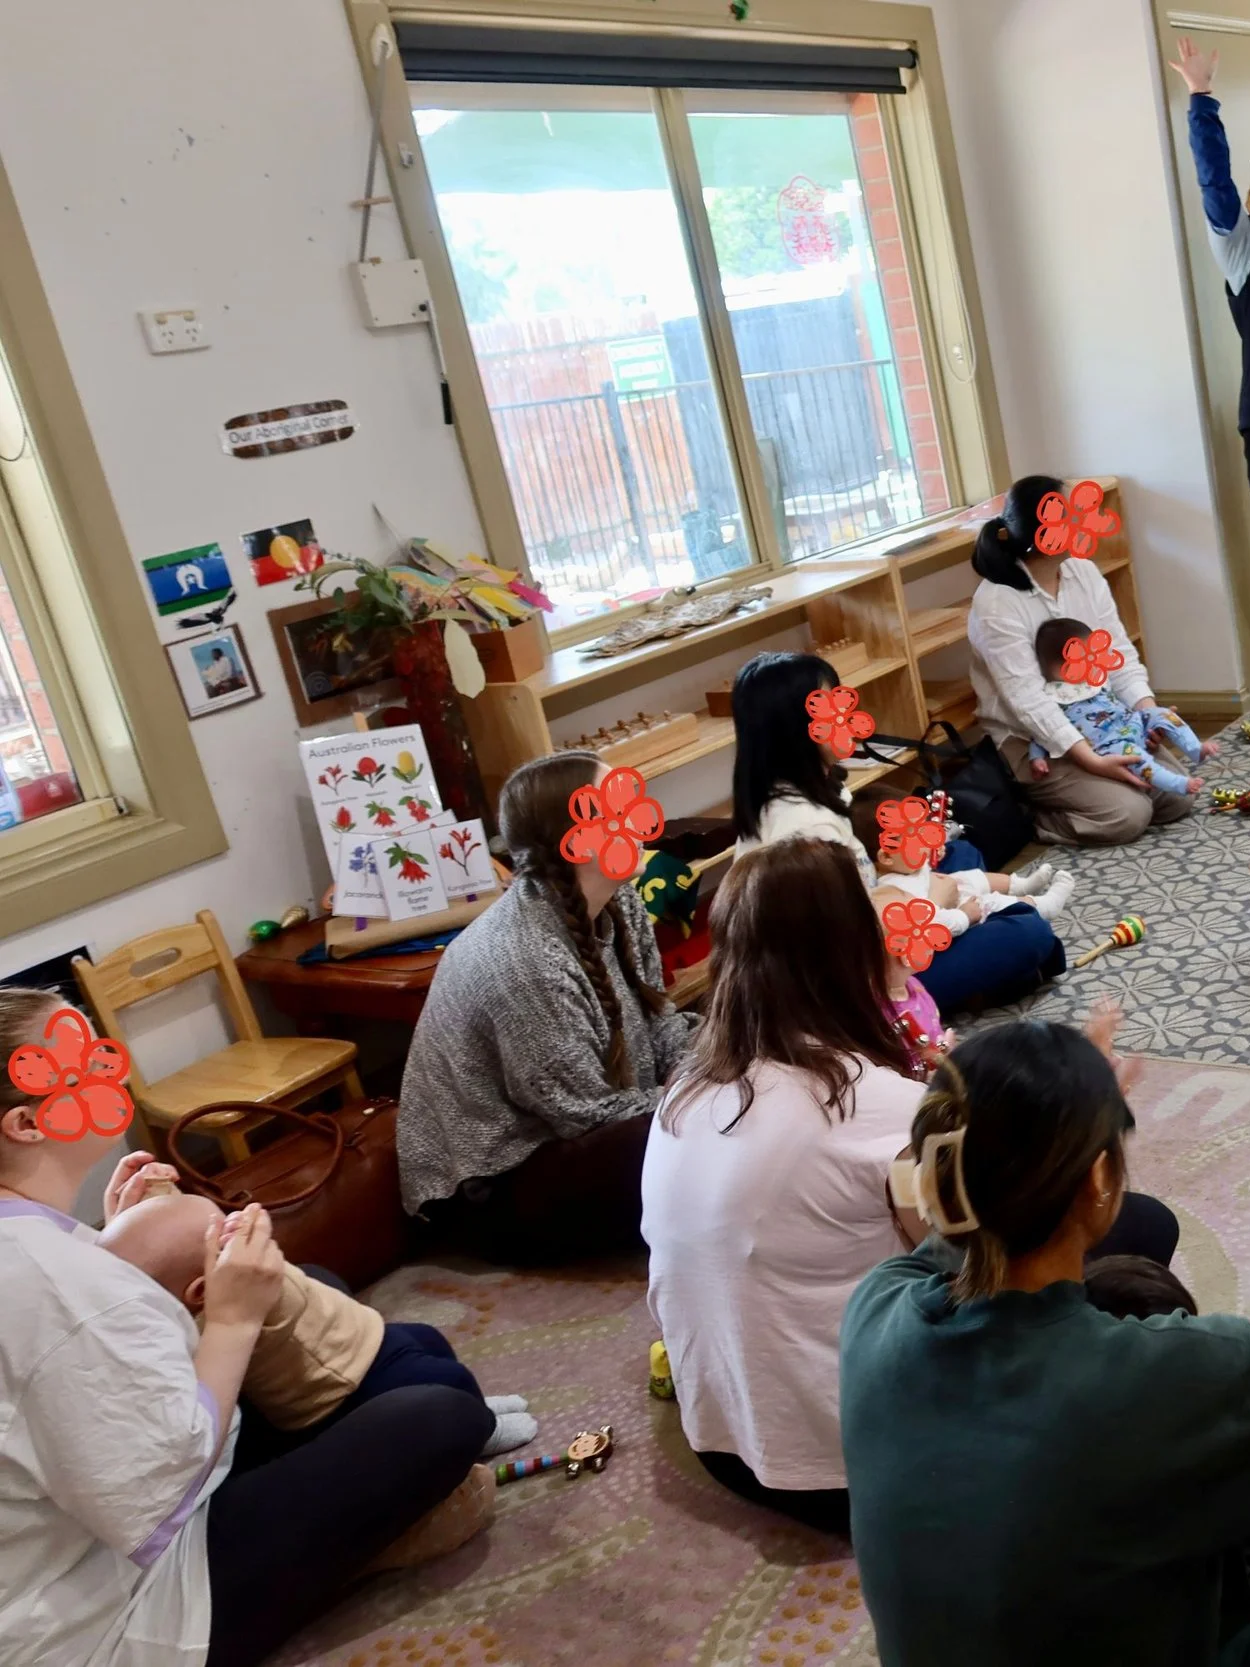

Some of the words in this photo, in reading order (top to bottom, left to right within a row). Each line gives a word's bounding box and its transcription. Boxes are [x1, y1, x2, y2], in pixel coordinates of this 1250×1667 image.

[228, 431, 251, 443] Our
[256, 419, 311, 436] Aboriginal
[309, 742, 369, 759] Australian
[371, 735, 416, 747] Flowers
